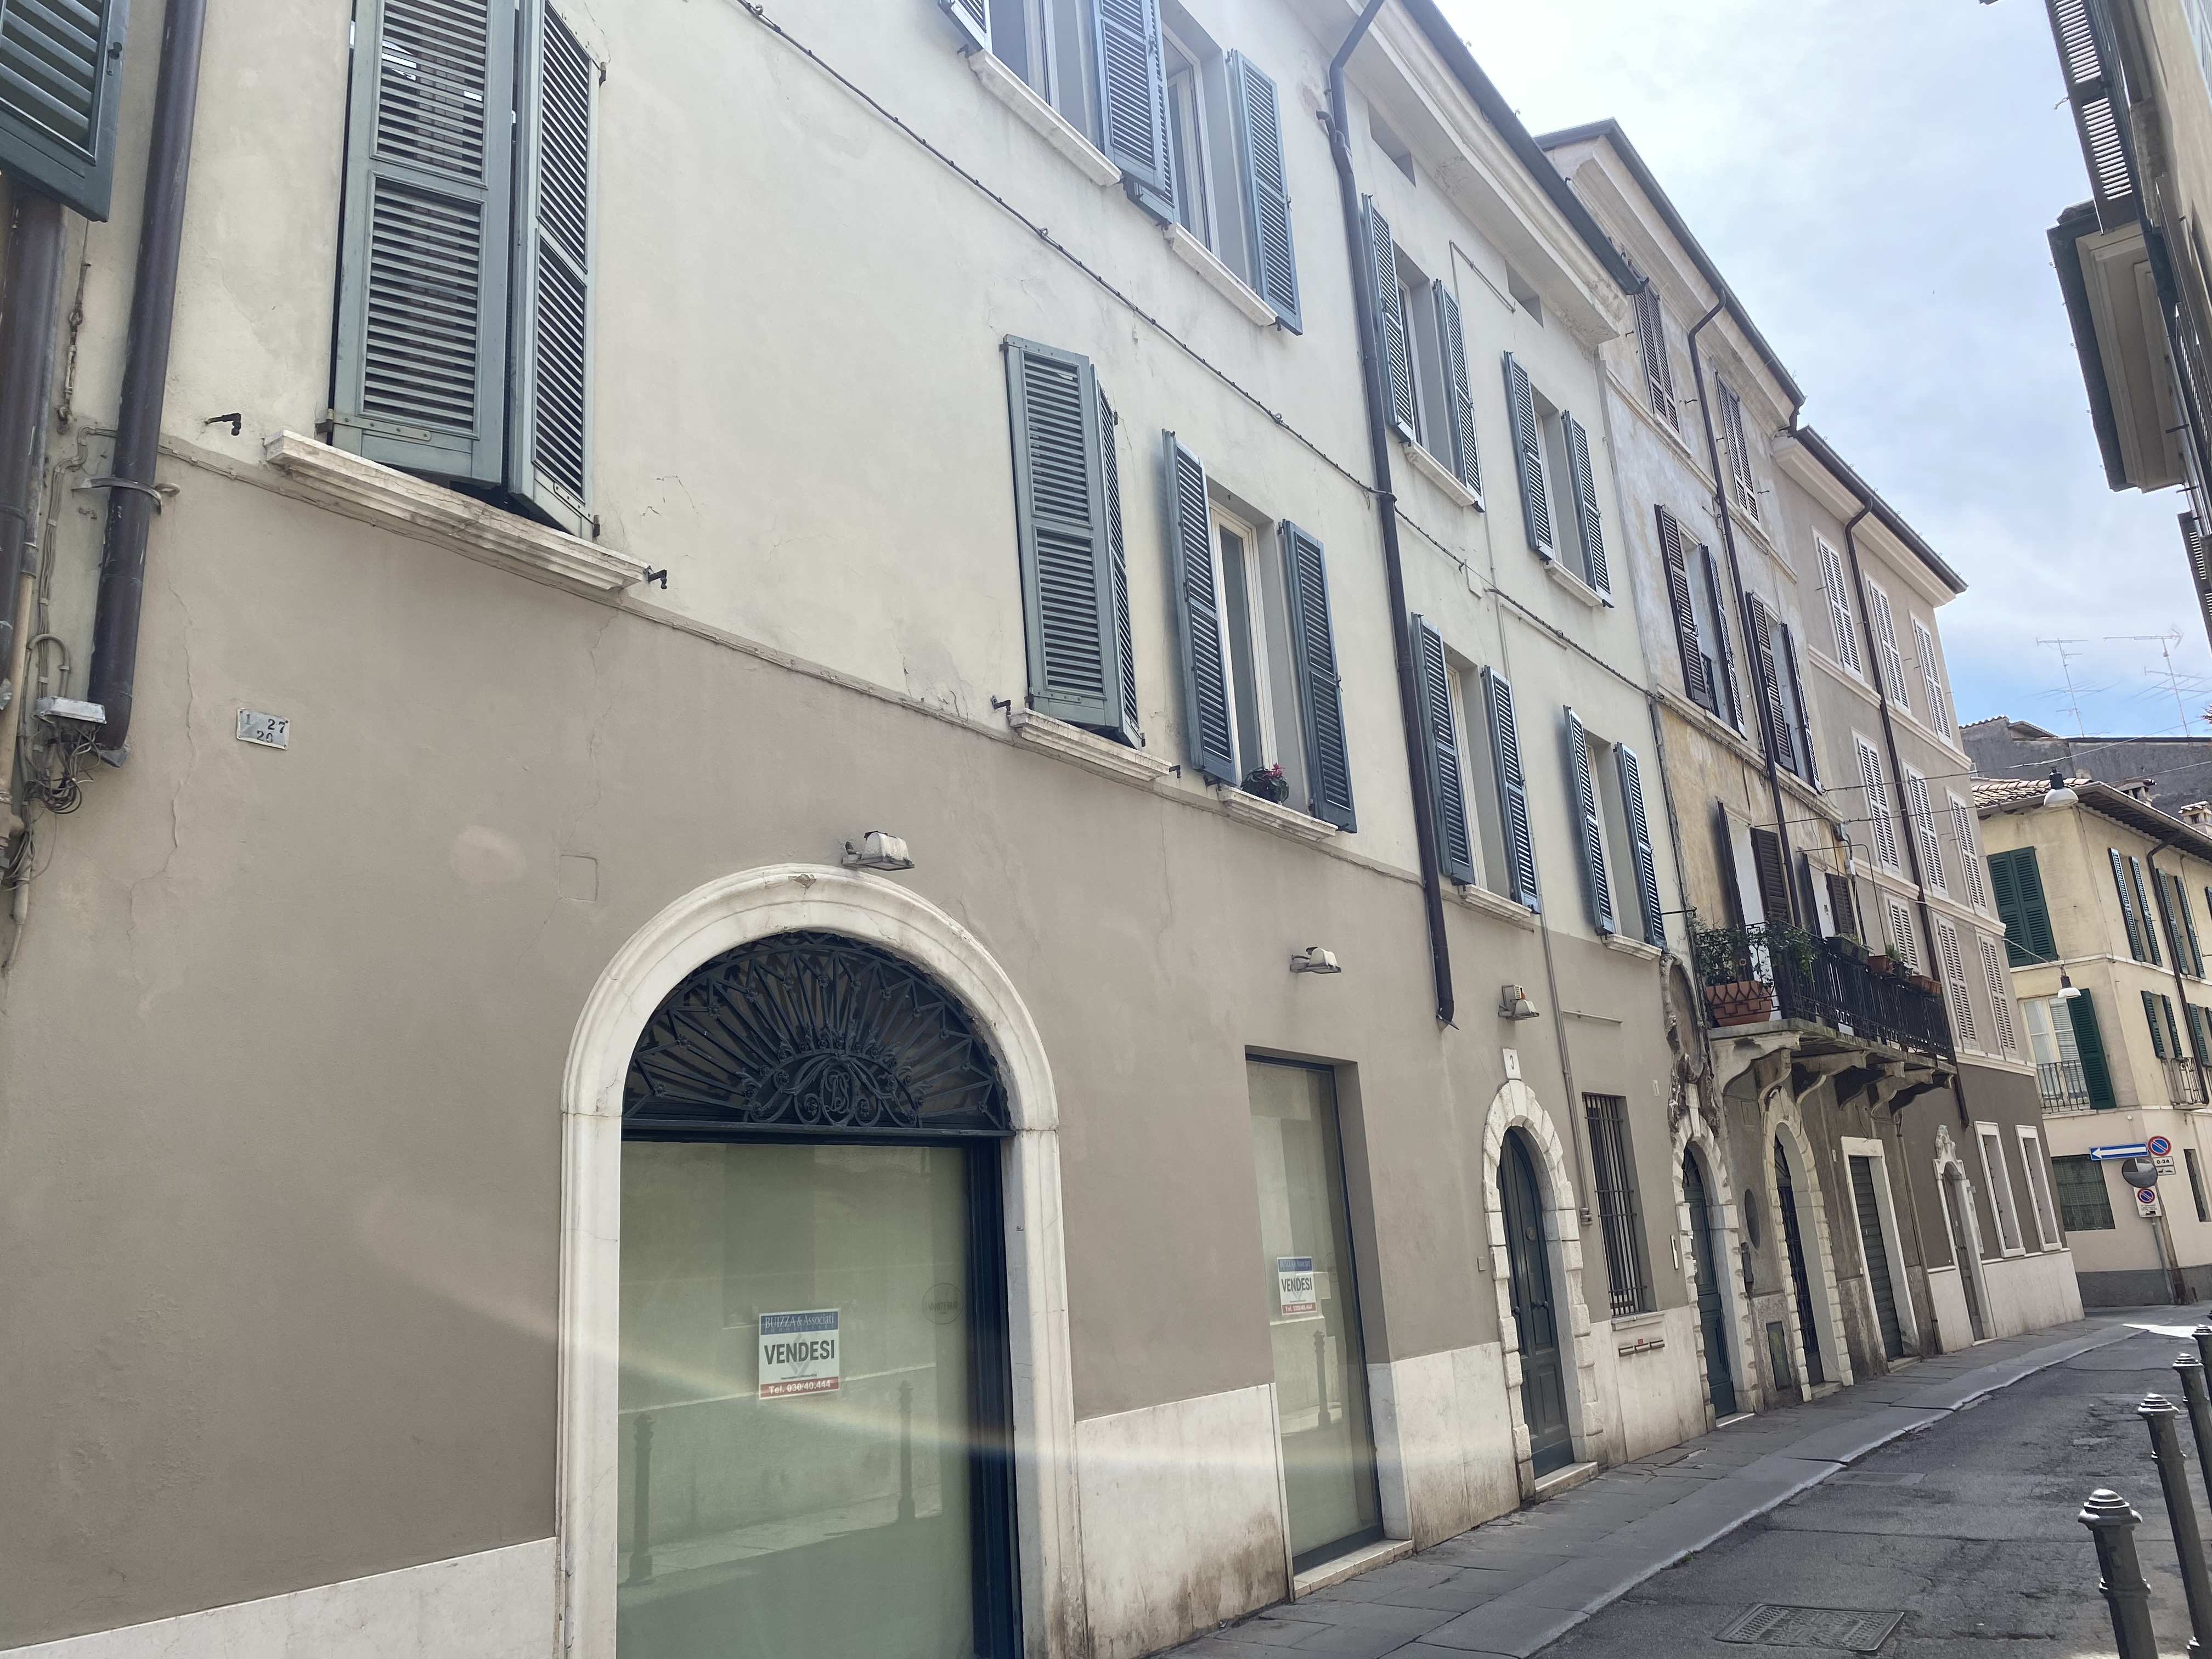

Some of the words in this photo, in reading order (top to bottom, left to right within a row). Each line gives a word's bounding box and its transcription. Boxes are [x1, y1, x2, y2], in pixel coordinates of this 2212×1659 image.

[267, 718, 285, 733] 27
[256, 730, 273, 743] 20
[1281, 1277, 1312, 1292] VENDESI
[765, 1316, 795, 1328] BUIZZA
[803, 1313, 834, 1325] Associati
[764, 1340, 834, 1365] VENDESI
[769, 1386, 785, 1395] Tel.
[787, 1380, 831, 1393] 030/40.444
